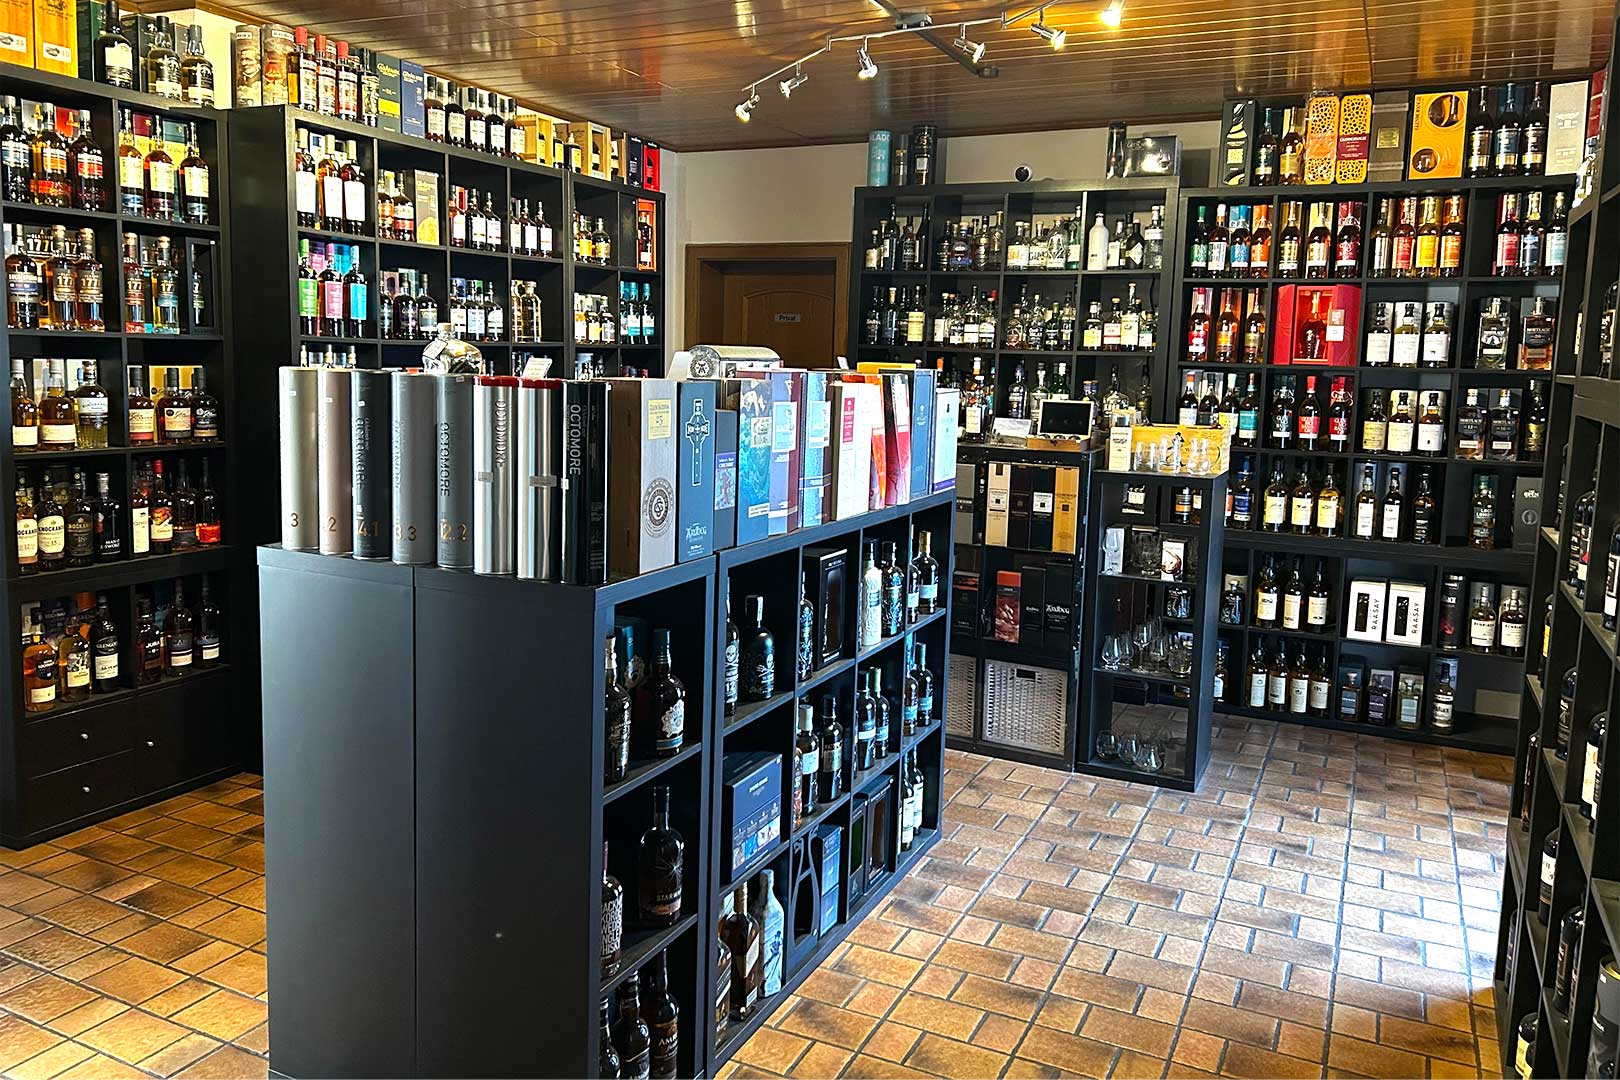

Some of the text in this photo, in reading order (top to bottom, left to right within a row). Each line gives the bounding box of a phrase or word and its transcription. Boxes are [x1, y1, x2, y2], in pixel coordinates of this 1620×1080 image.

[440, 421, 450, 497] OCTOMORE
[569, 403, 582, 476] OCTOMORE
[1371, 598, 1380, 630] RAASAY
[1411, 602, 1420, 634] RAASAY
